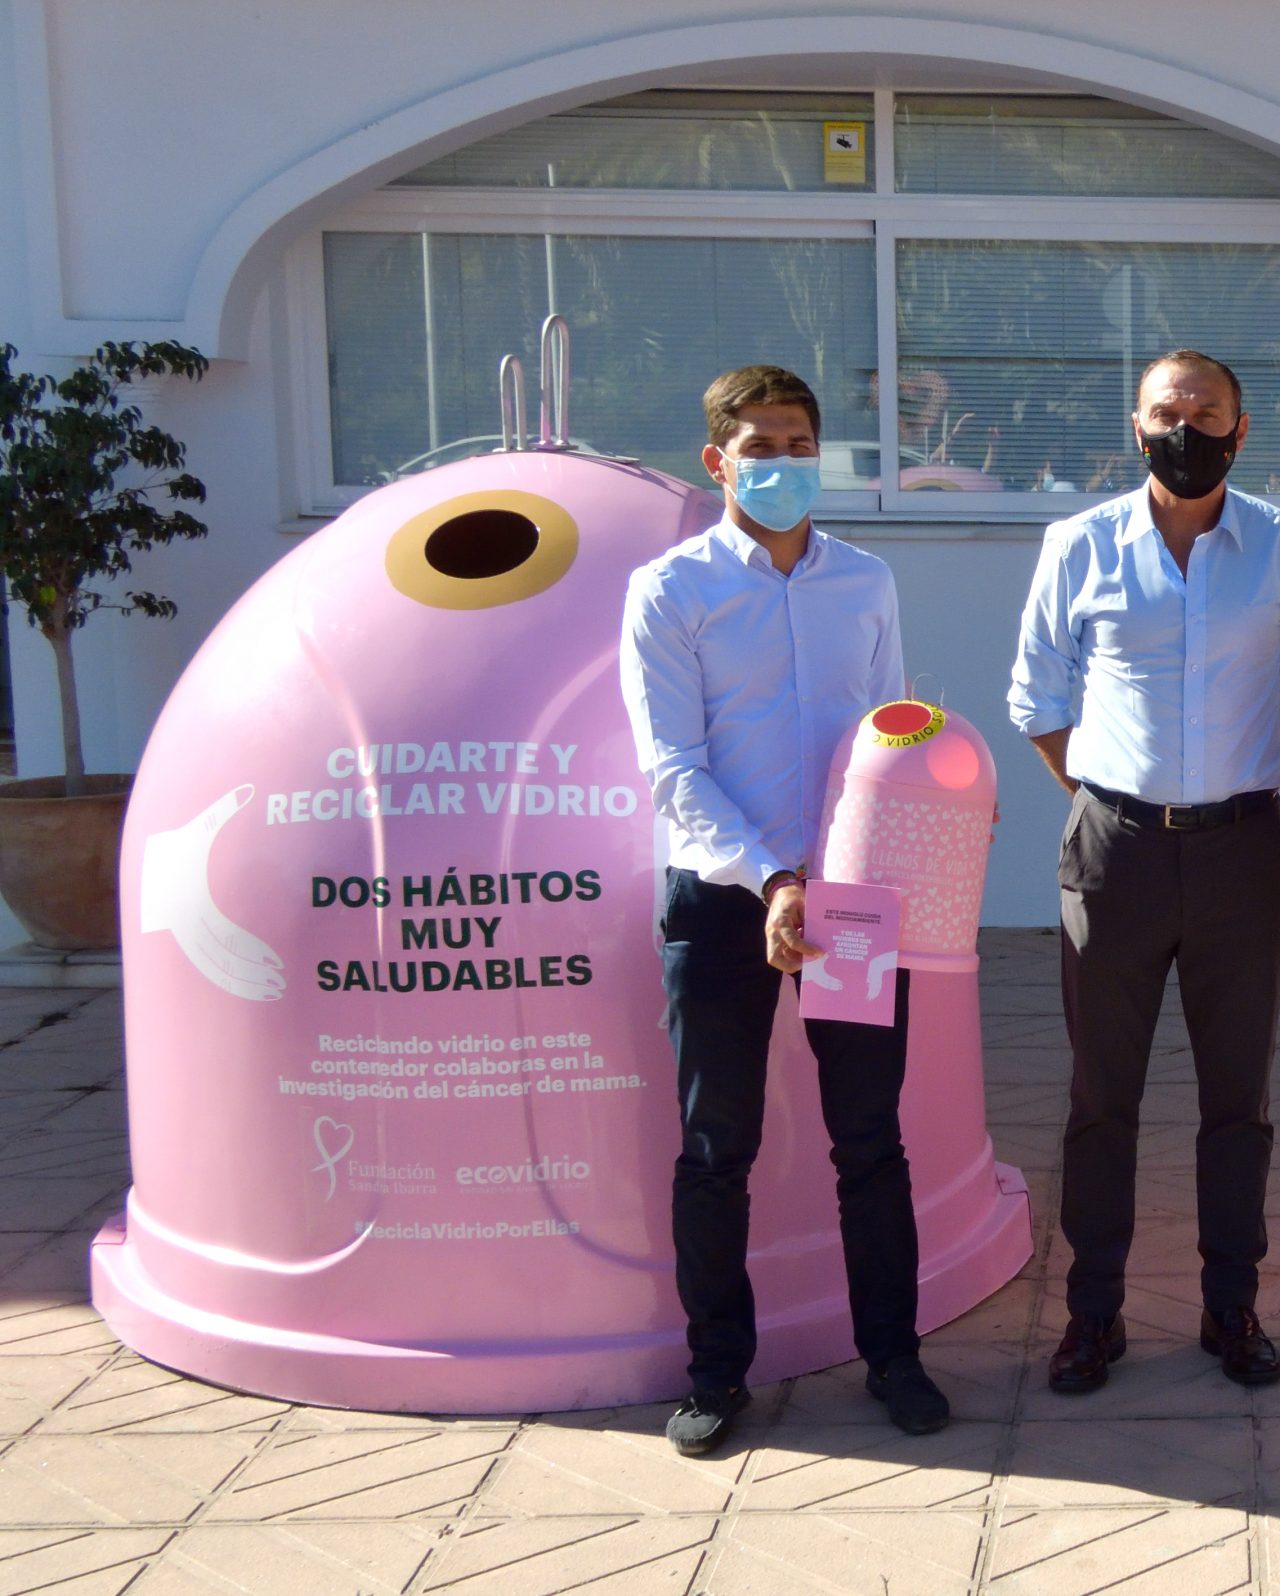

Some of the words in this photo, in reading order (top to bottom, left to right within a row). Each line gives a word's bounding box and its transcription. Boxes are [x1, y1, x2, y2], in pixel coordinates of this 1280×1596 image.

[887, 726, 934, 747] VIDRIO
[326, 741, 540, 779] CUIDARTE
[550, 743, 579, 775] Y
[266, 782, 466, 826] RECICLAR
[475, 782, 639, 817] VIDRIO
[311, 875, 391, 909] DOS
[402, 867, 602, 908] HÁBITOS
[400, 915, 503, 951] MUY
[316, 955, 594, 993] SALUDABLES
[319, 1034, 433, 1055] Reciclando
[437, 1034, 505, 1054] vidrio
[509, 1034, 537, 1051] en
[541, 1031, 592, 1048] este
[311, 1058, 428, 1077] contenedor
[433, 1056, 546, 1077] colaboras
[550, 1054, 579, 1071] en
[583, 1051, 604, 1070] la
[278, 1075, 409, 1101] investigación
[413, 1079, 448, 1099] del
[453, 1078, 532, 1098] cáncer
[536, 1075, 565, 1093] de
[570, 1072, 648, 1092] mama.
[348, 1160, 436, 1181] Fundación
[455, 1155, 591, 1185] ecovidrio
